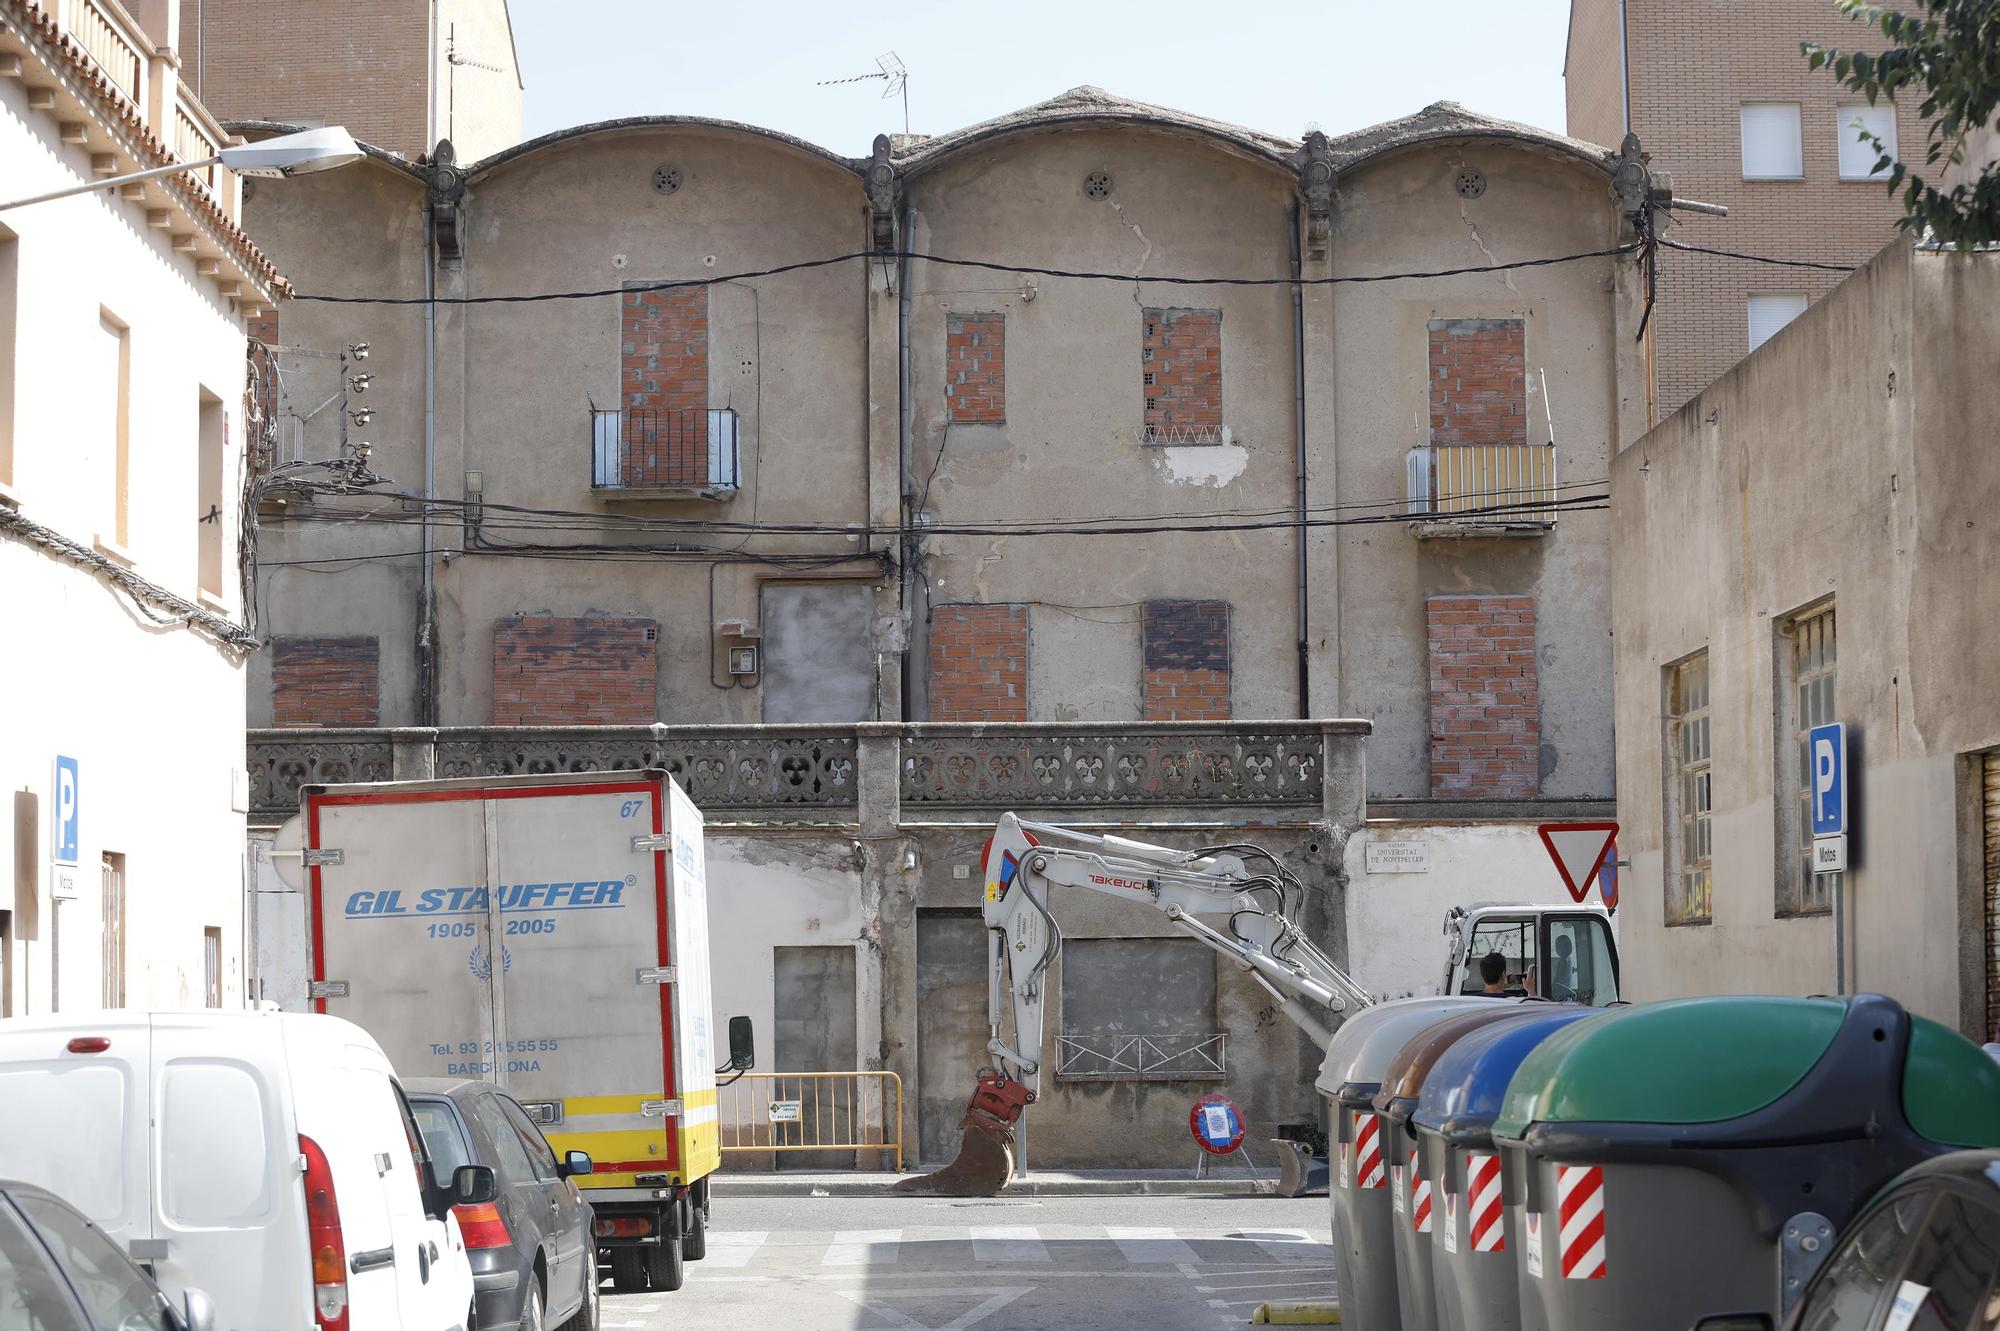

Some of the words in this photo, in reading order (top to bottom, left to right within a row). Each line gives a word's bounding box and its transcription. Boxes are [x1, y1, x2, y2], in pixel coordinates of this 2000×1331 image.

[1815, 739, 1835, 822] P
[60, 767, 75, 849] P
[620, 800, 643, 818] 67
[1819, 847, 1837, 863] Motos
[345, 890, 406, 915] GIL
[415, 880, 625, 914] STAUFFER
[426, 922, 476, 939] 1905
[505, 918, 556, 935] 2005
[430, 1043, 453, 1056] Tel.
[459, 1042, 478, 1055] 93
